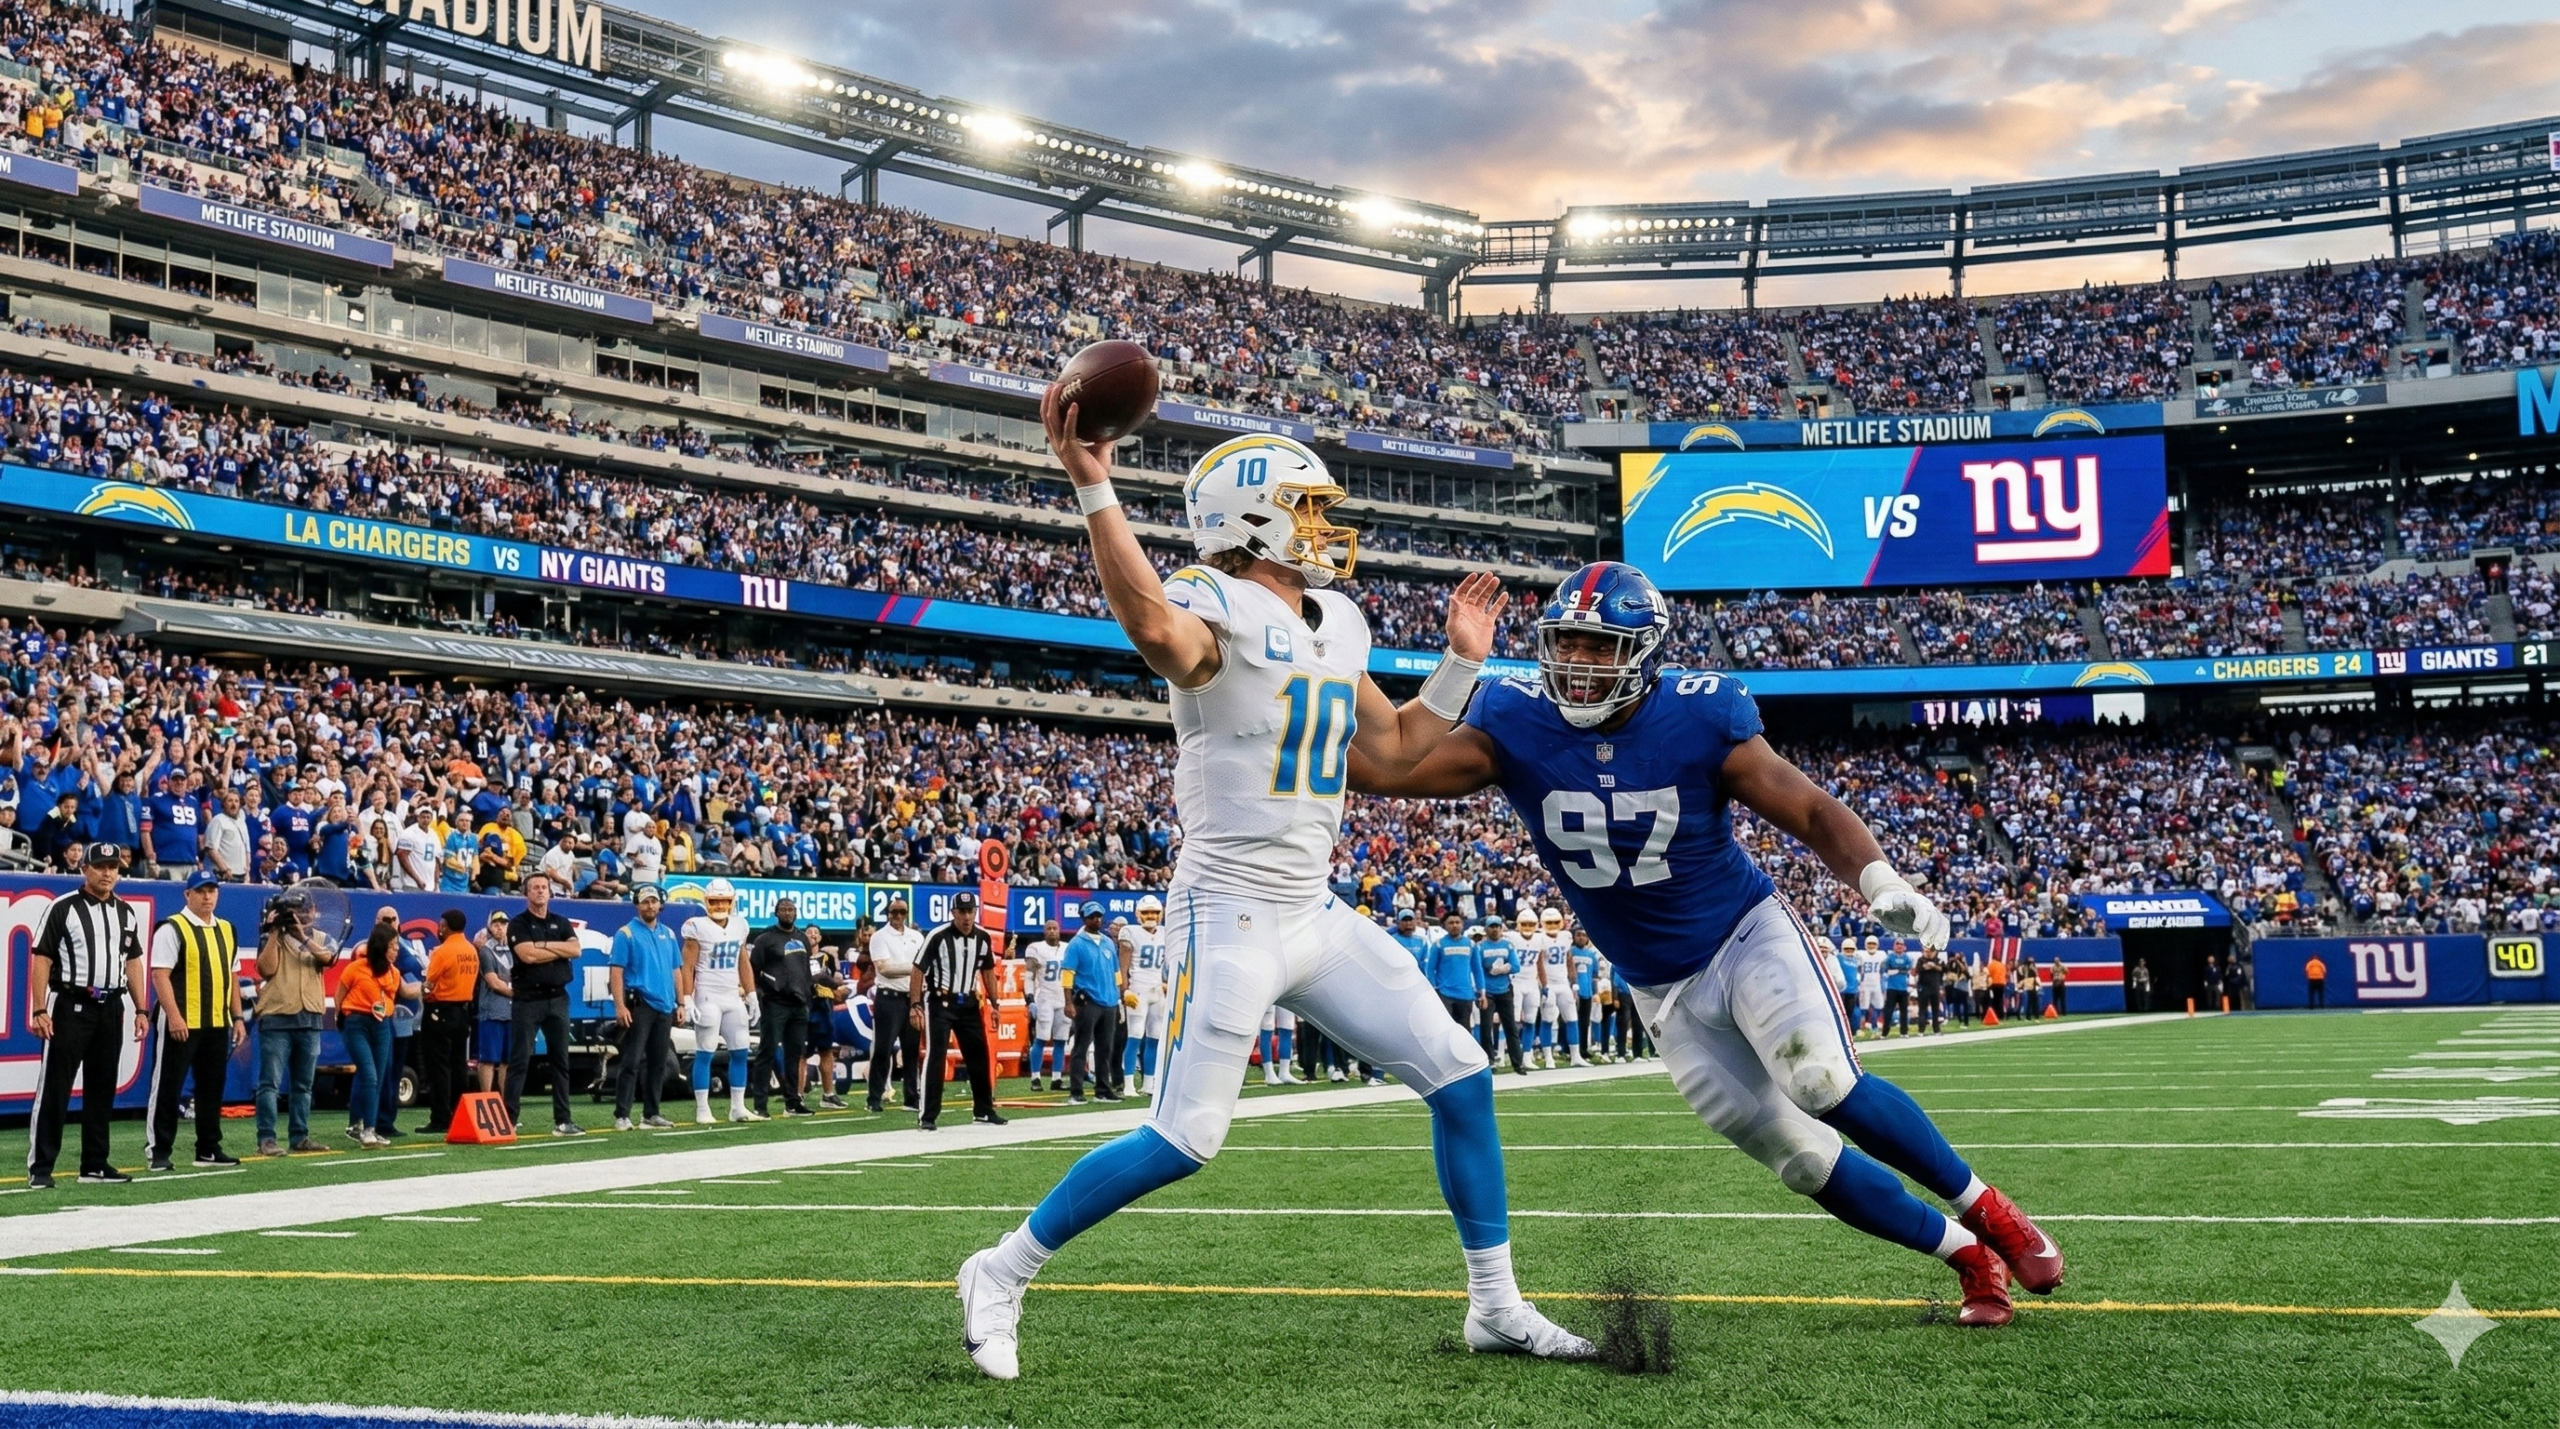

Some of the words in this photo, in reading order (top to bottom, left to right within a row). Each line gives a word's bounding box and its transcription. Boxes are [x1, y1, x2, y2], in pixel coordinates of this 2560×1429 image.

[201, 203, 267, 235] METLIFE
[269, 220, 335, 250] STADIUM
[494, 272, 549, 298] METLIFE
[549, 283, 605, 310] STADIUM
[745, 325, 793, 349] METLIFE
[1802, 419, 1893, 446] METLIFE
[1897, 415, 1992, 443] STADIUM
[1236, 457, 1267, 488] 10
[1863, 493, 1921, 539] VS
[285, 513, 321, 546] LA
[329, 520, 471, 567] CHARGERS
[492, 546, 520, 572] VS
[540, 549, 573, 581] NY
[579, 556, 666, 594] GIANTS
[2212, 656, 2320, 681] CHARGERS
[2334, 653, 2362, 675] 24
[2421, 648, 2499, 671] GIANTS
[2523, 644, 2548, 665] 21
[1269, 673, 1358, 799] 10
[1541, 785, 1680, 889] 97
[1023, 896, 1046, 926] 21
[2497, 943, 2535, 970] 40
[475, 1097, 511, 1137] 40
